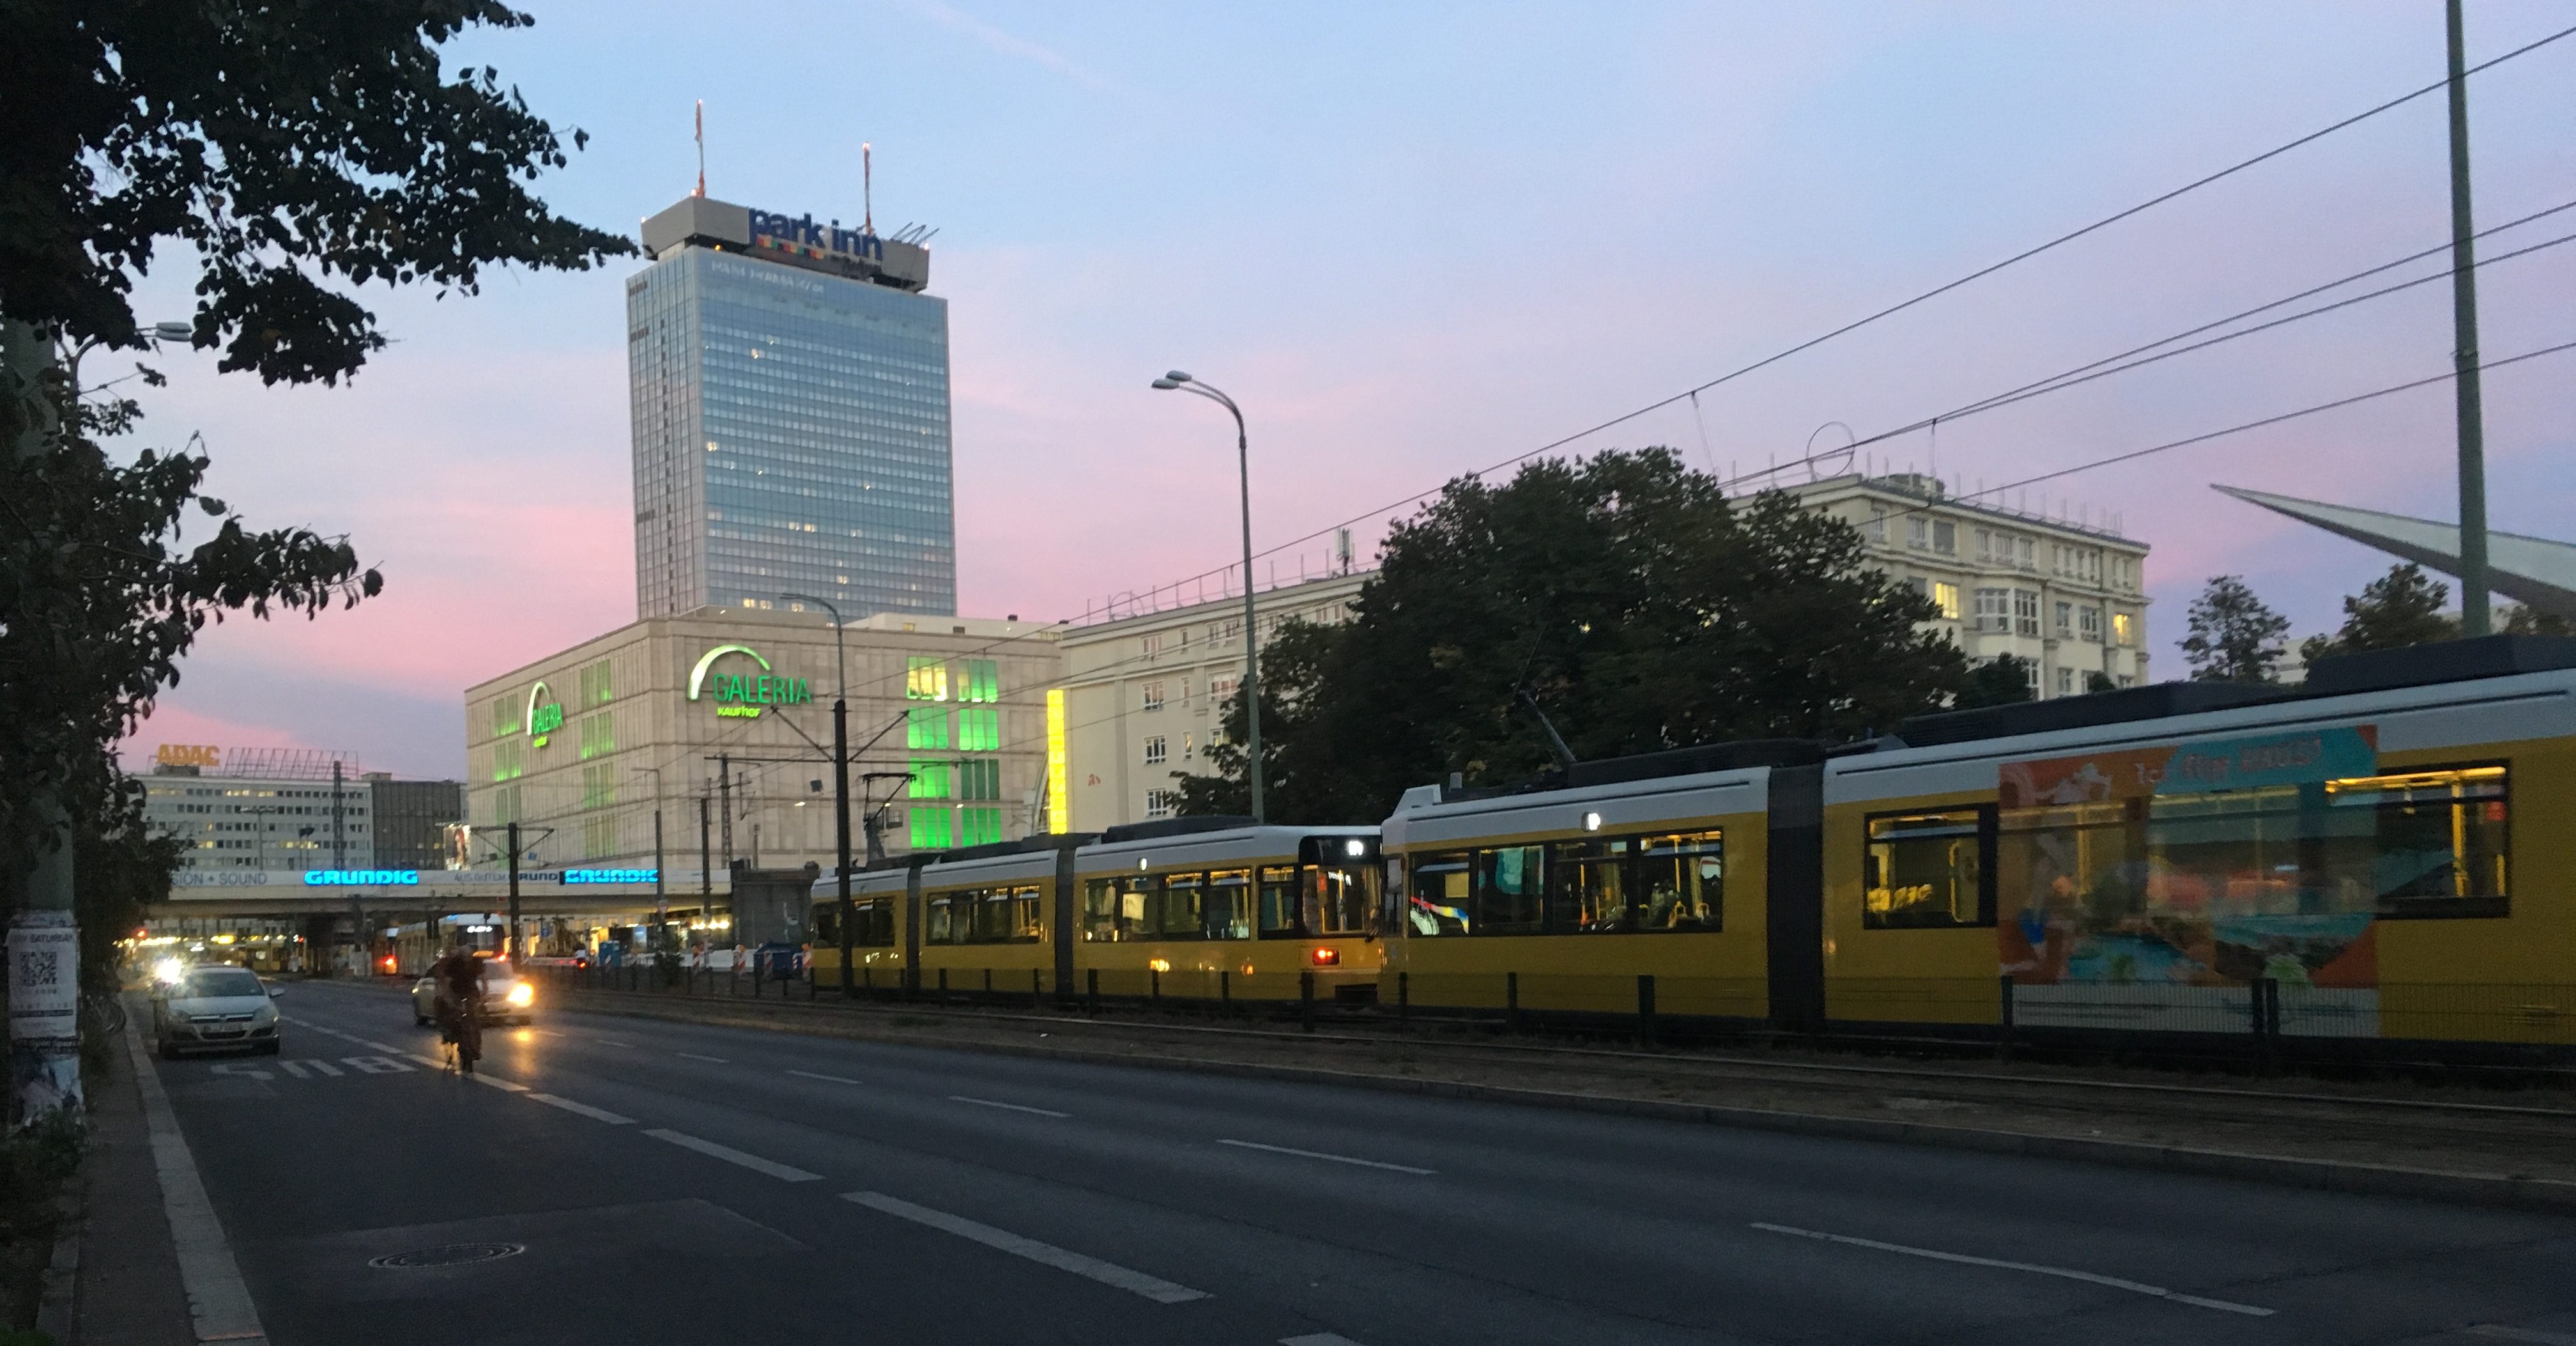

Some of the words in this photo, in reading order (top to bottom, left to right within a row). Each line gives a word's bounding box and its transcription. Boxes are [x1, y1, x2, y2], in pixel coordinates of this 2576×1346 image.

[749, 208, 825, 248] park
[832, 219, 882, 260] inn
[713, 674, 812, 704] GALERIA
[157, 744, 220, 766] ADAC
[219, 872, 267, 885] SOUND
[304, 870, 418, 886] GRUNDIG
[510, 872, 558, 881] RUND
